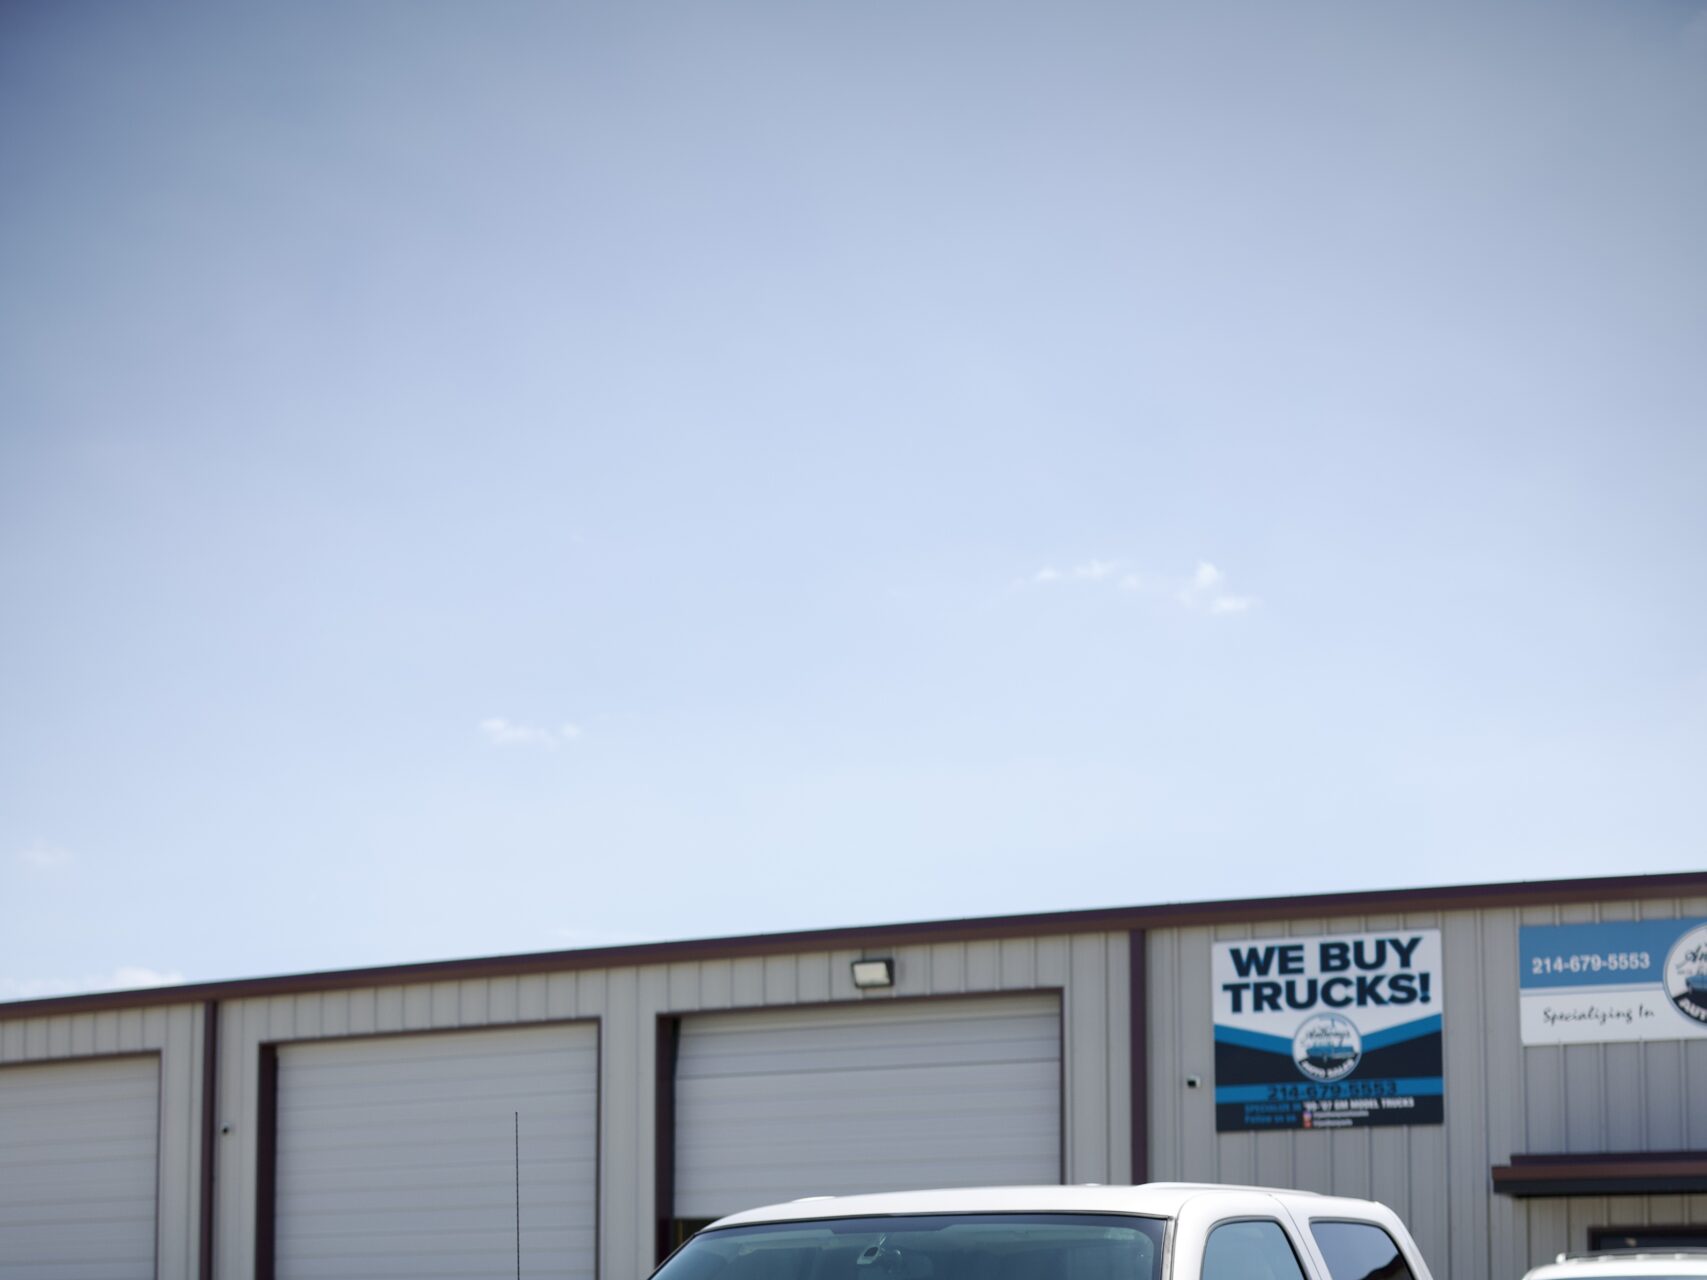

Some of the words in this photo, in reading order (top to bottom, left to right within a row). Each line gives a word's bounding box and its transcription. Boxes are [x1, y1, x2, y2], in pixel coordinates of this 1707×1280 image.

[1229, 944, 1304, 977] WE
[1319, 937, 1422, 973] BUY
[1532, 952, 1650, 974] 214-679-5553
[1222, 972, 1431, 1014] TRUCKS!
[1543, 1005, 1633, 1025] Specializing
[1638, 1002, 1655, 1018] In
[1350, 1098, 1379, 1110] MODEL
[1381, 1096, 1415, 1109] TRUCKS
